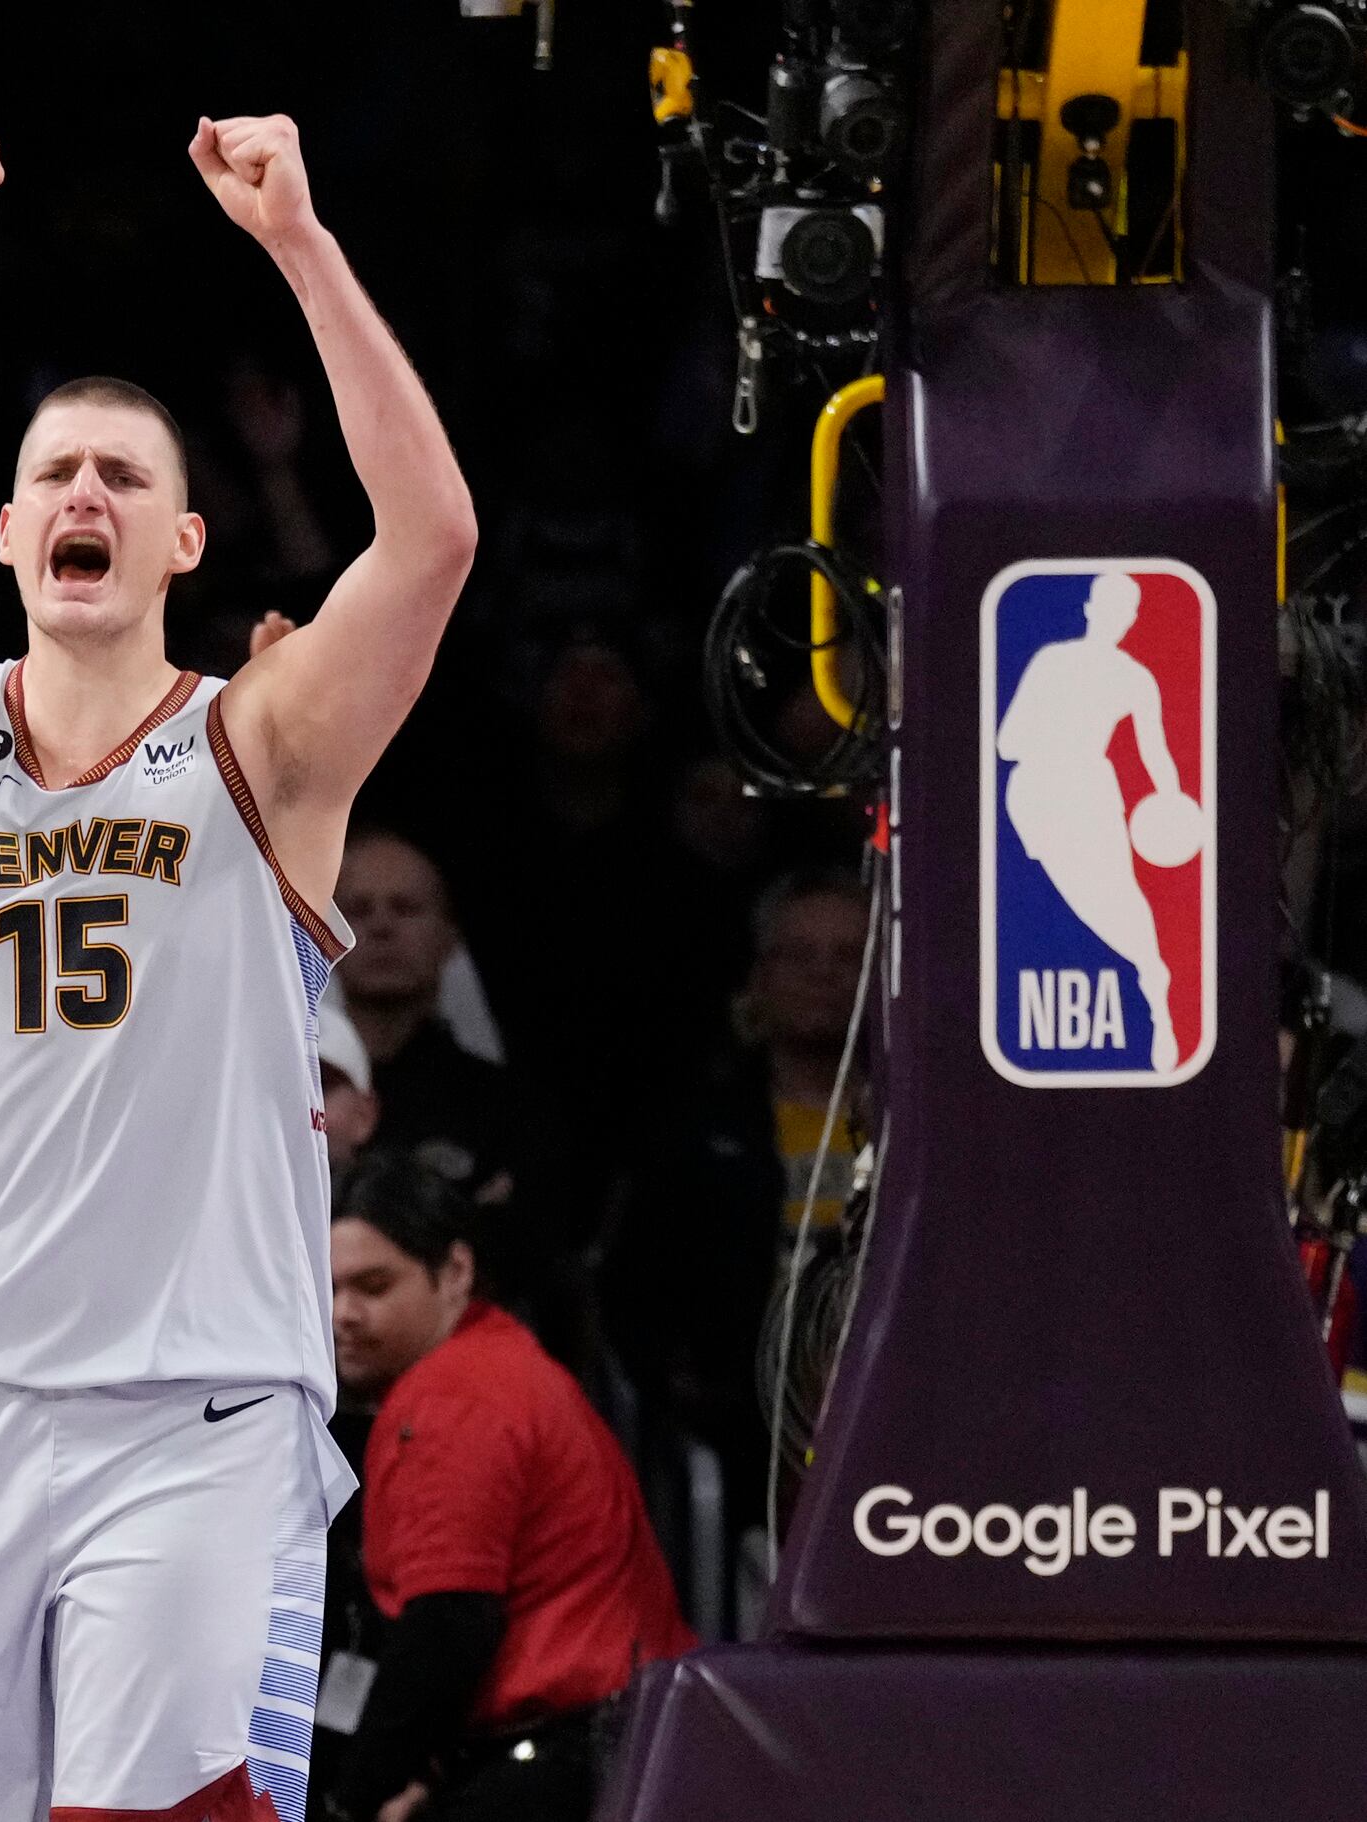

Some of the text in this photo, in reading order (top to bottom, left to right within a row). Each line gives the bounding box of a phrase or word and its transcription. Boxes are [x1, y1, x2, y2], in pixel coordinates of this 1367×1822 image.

[144, 735, 194, 764] WU
[144, 755, 194, 776] Western
[153, 767, 187, 785] Union
[1019, 968, 1126, 1050] NBA
[853, 1484, 1331, 1577] Google Pixel
